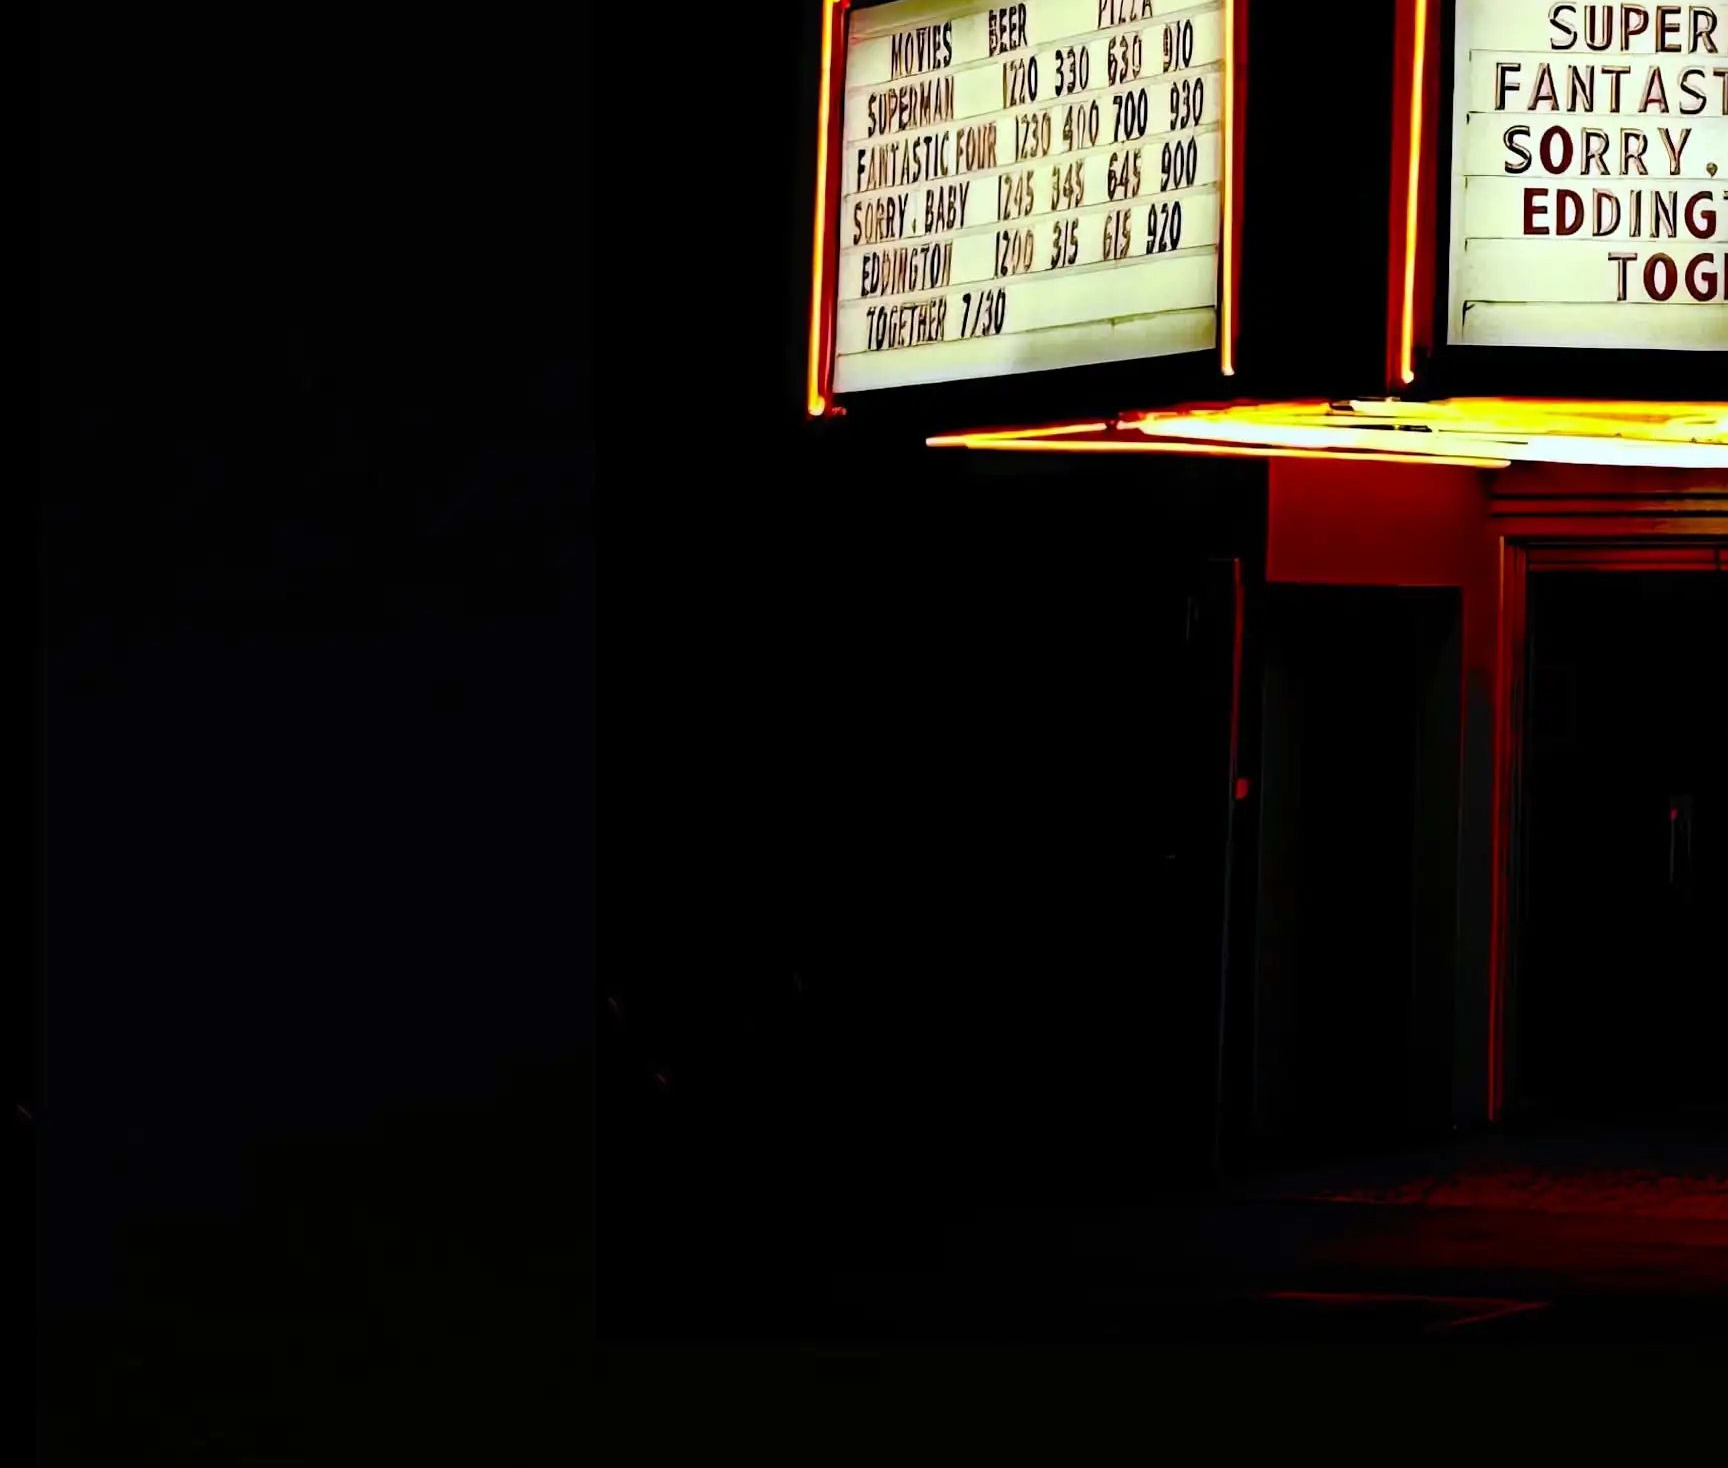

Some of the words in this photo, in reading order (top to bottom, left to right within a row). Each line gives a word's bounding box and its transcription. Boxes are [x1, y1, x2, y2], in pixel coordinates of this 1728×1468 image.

[867, 75, 955, 138] SUPERMAN
[1002, 56, 1039, 109] 1220
[1055, 45, 1090, 96] 330
[1107, 35, 1143, 87] 630
[1163, 19, 1194, 72] 910
[891, 20, 953, 80] MOVIES
[988, 2, 1028, 57] BEER
[857, 130, 950, 193] FANTASTIC
[956, 120, 997, 175] FOUR
[1015, 108, 1051, 164] 1230
[1062, 99, 1100, 152] 400
[1112, 90, 1149, 143] 700
[1170, 77, 1204, 131] 930
[925, 180, 970, 235] BABY
[998, 169, 1035, 223] 1245
[1051, 159, 1085, 211] 345
[1107, 149, 1142, 202] 645
[1161, 135, 1198, 191] 900
[861, 239, 953, 298] EDDINGTON
[994, 229, 1034, 280] 1200
[1050, 218, 1079, 270] 315
[1103, 208, 1132, 261] 615
[1146, 201, 1182, 255] 920
[867, 296, 946, 352] TOGETHER
[960, 287, 1006, 341] 7/30
